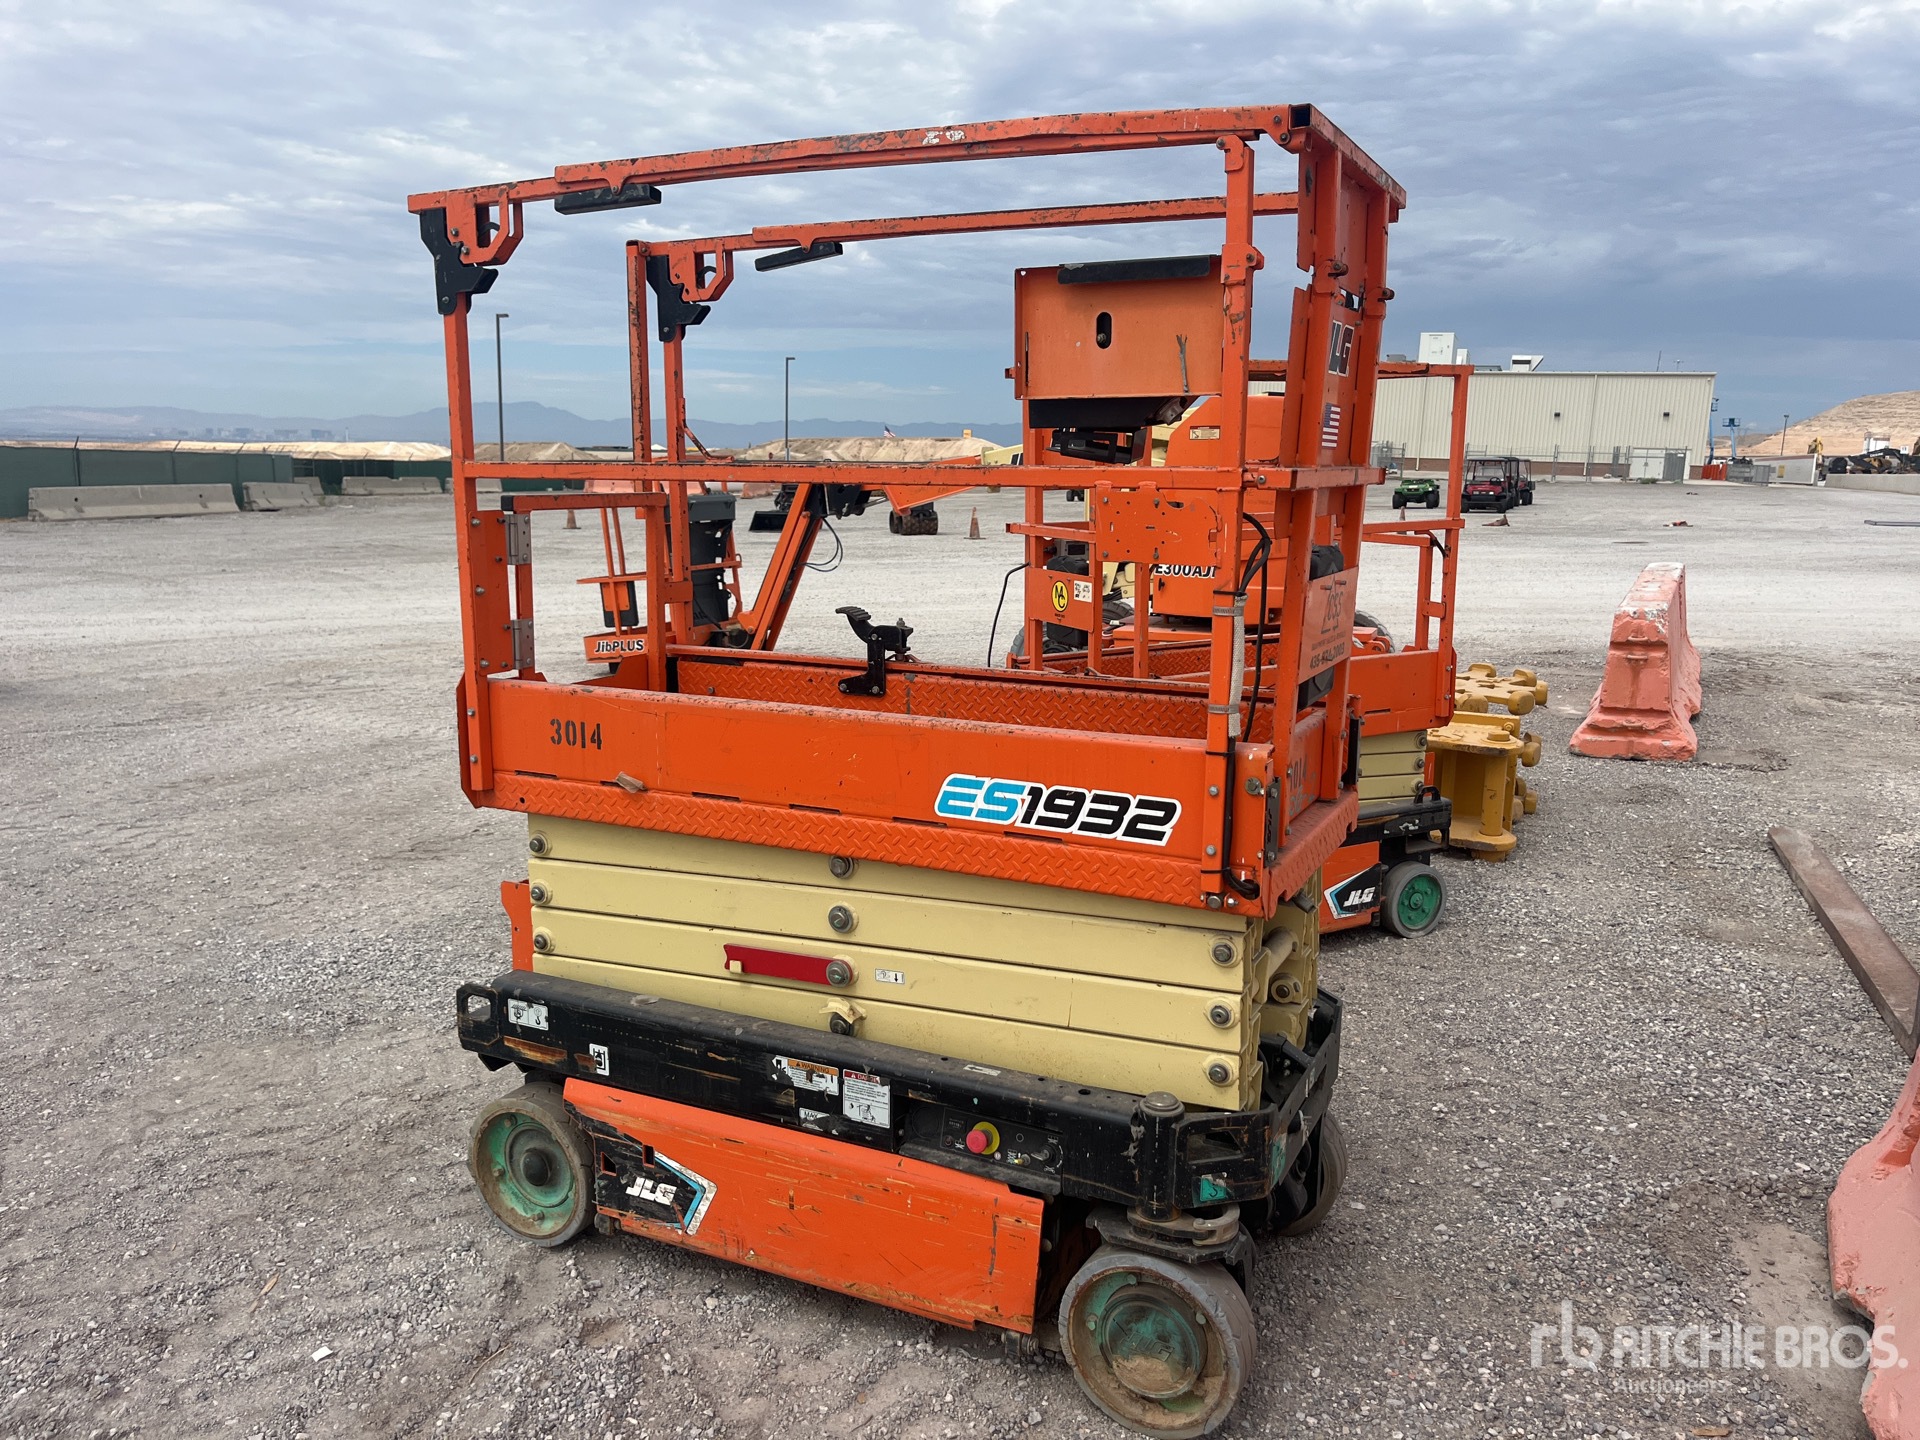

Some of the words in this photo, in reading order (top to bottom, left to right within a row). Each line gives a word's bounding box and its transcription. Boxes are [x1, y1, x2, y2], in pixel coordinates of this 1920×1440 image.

[594, 639, 645, 653] JibPLUS
[549, 718, 602, 750] 3014
[935, 775, 1181, 845] ES1932
[1343, 887, 1376, 908] JLG
[626, 1176, 677, 1206] JLG
